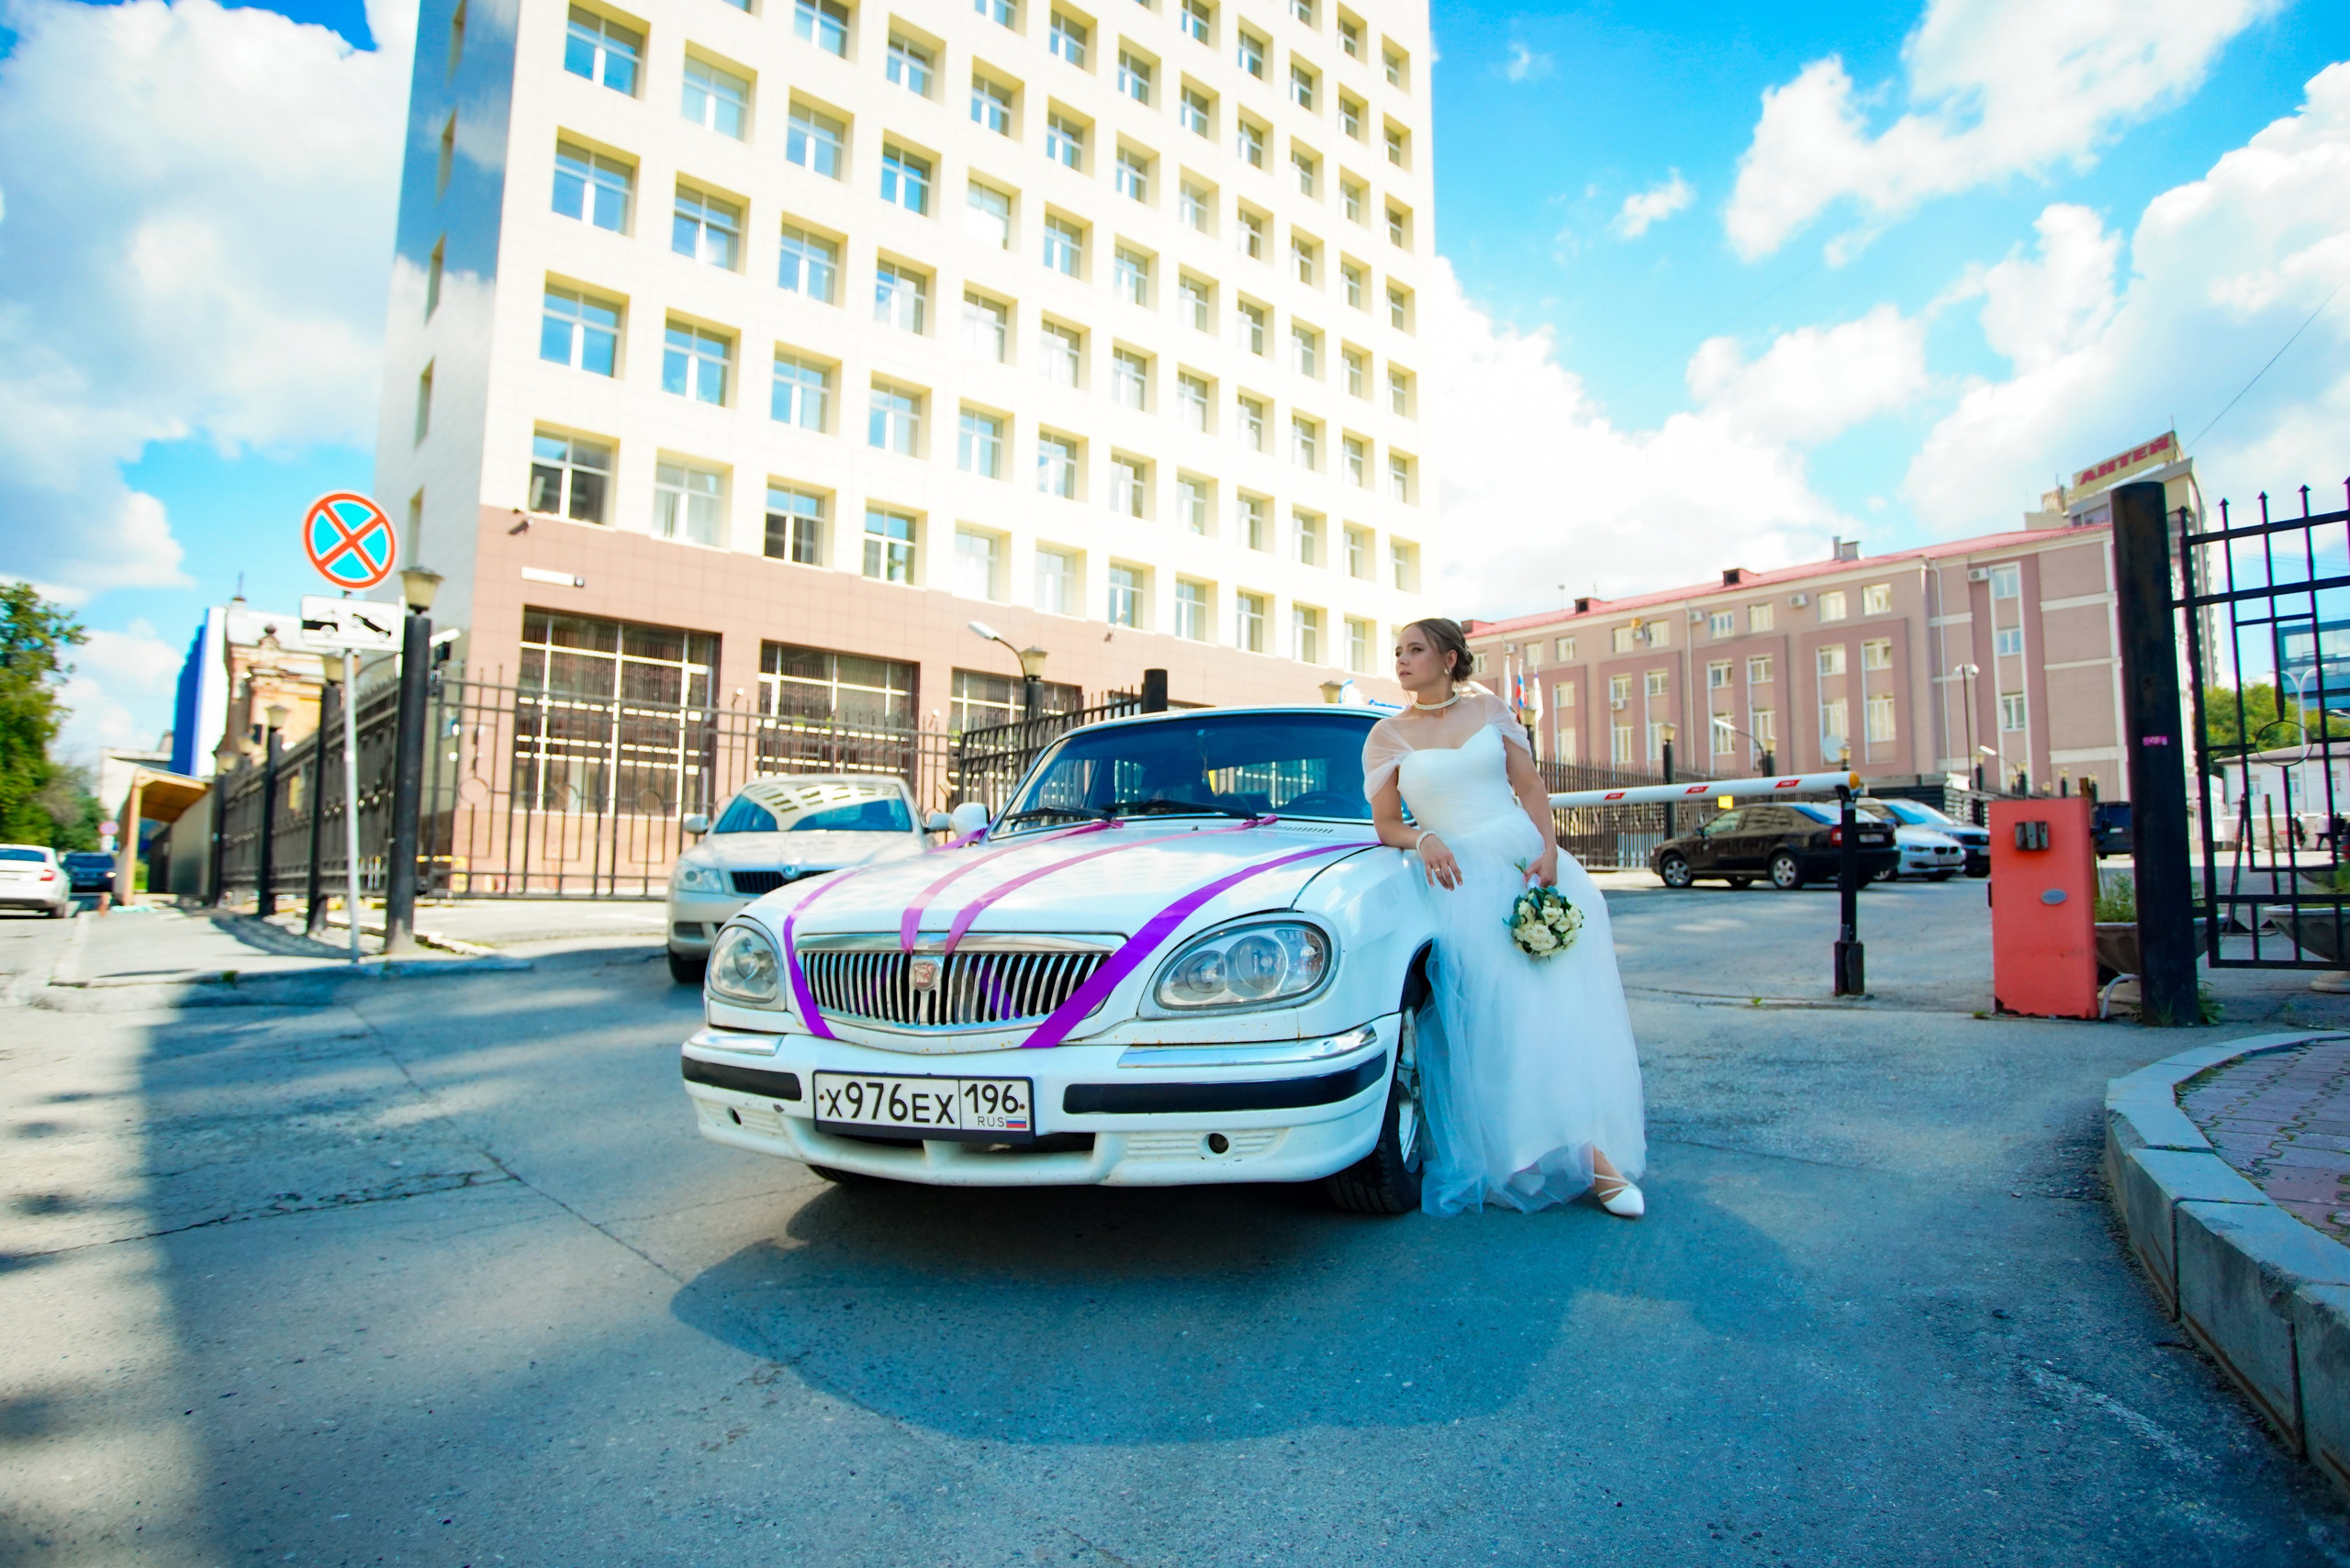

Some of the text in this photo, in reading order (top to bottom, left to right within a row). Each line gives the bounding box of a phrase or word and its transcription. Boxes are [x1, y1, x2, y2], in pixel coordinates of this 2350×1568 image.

[2079, 435, 2169, 486] АНТЕЙ
[964, 1083, 1019, 1114] 196
[977, 1115, 1005, 1128] RUS
